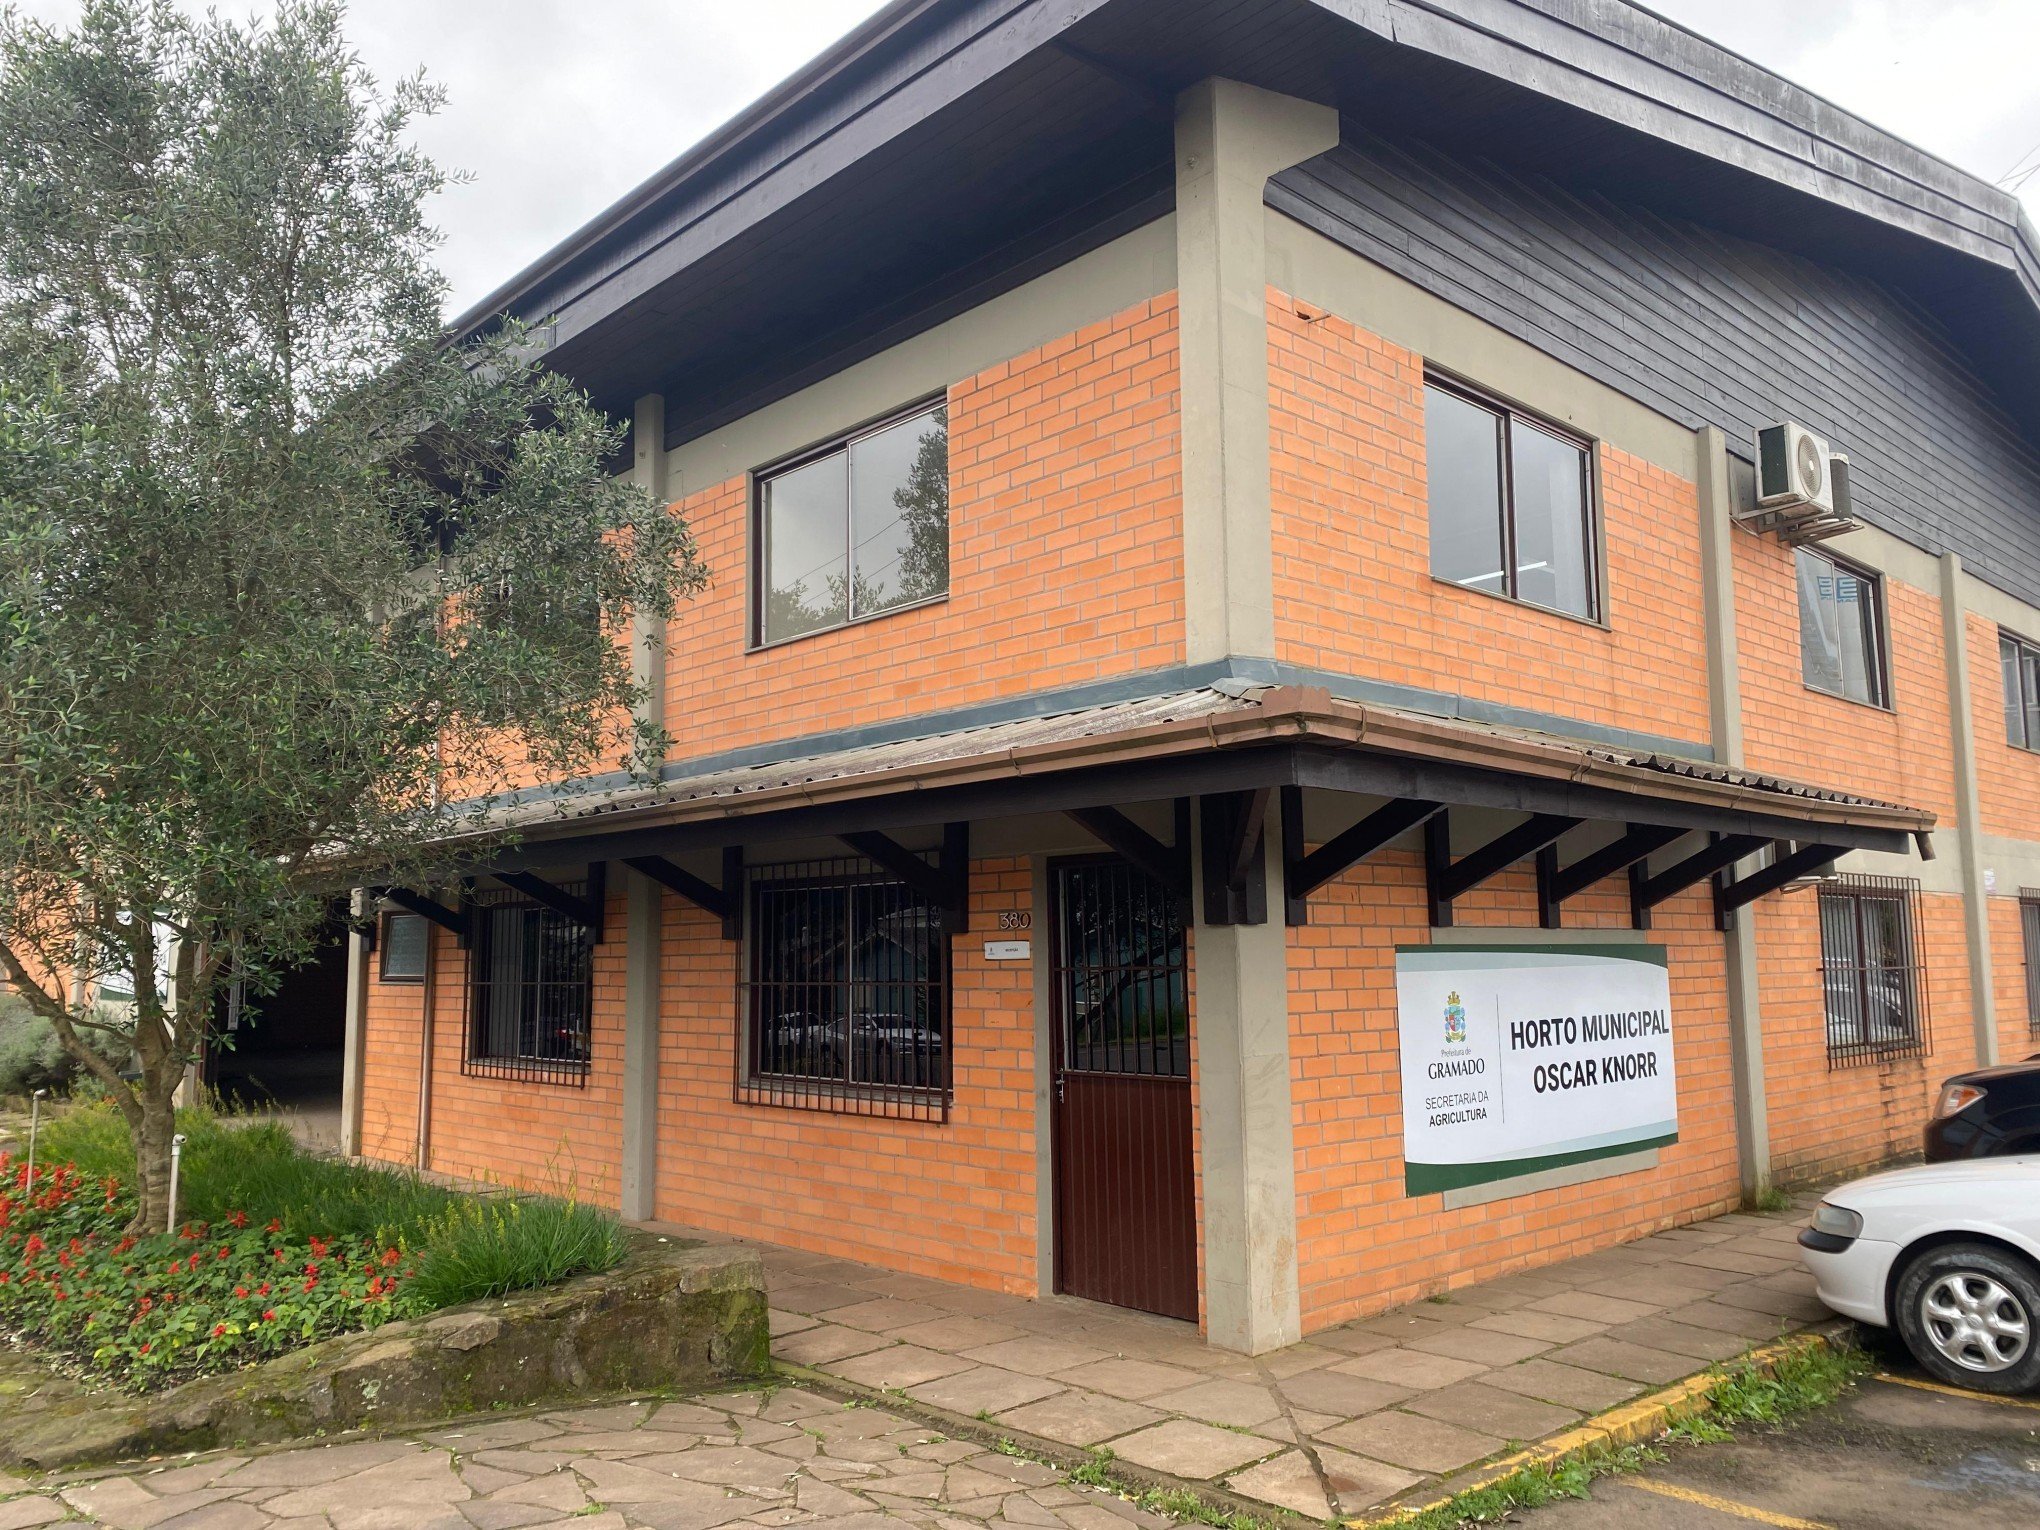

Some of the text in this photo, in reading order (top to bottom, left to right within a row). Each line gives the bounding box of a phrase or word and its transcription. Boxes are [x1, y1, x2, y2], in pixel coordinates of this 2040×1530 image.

[1000, 912, 1031, 930] 380
[1510, 1009, 1670, 1050] HORTO MUNICIPAL
[1428, 1058, 1485, 1080] GRAMADO
[1533, 1051, 1658, 1093] OSCAR KNORR
[1425, 1090, 1489, 1110] SECRETARIA DA
[1429, 1107, 1487, 1127] AGRICULTURA
